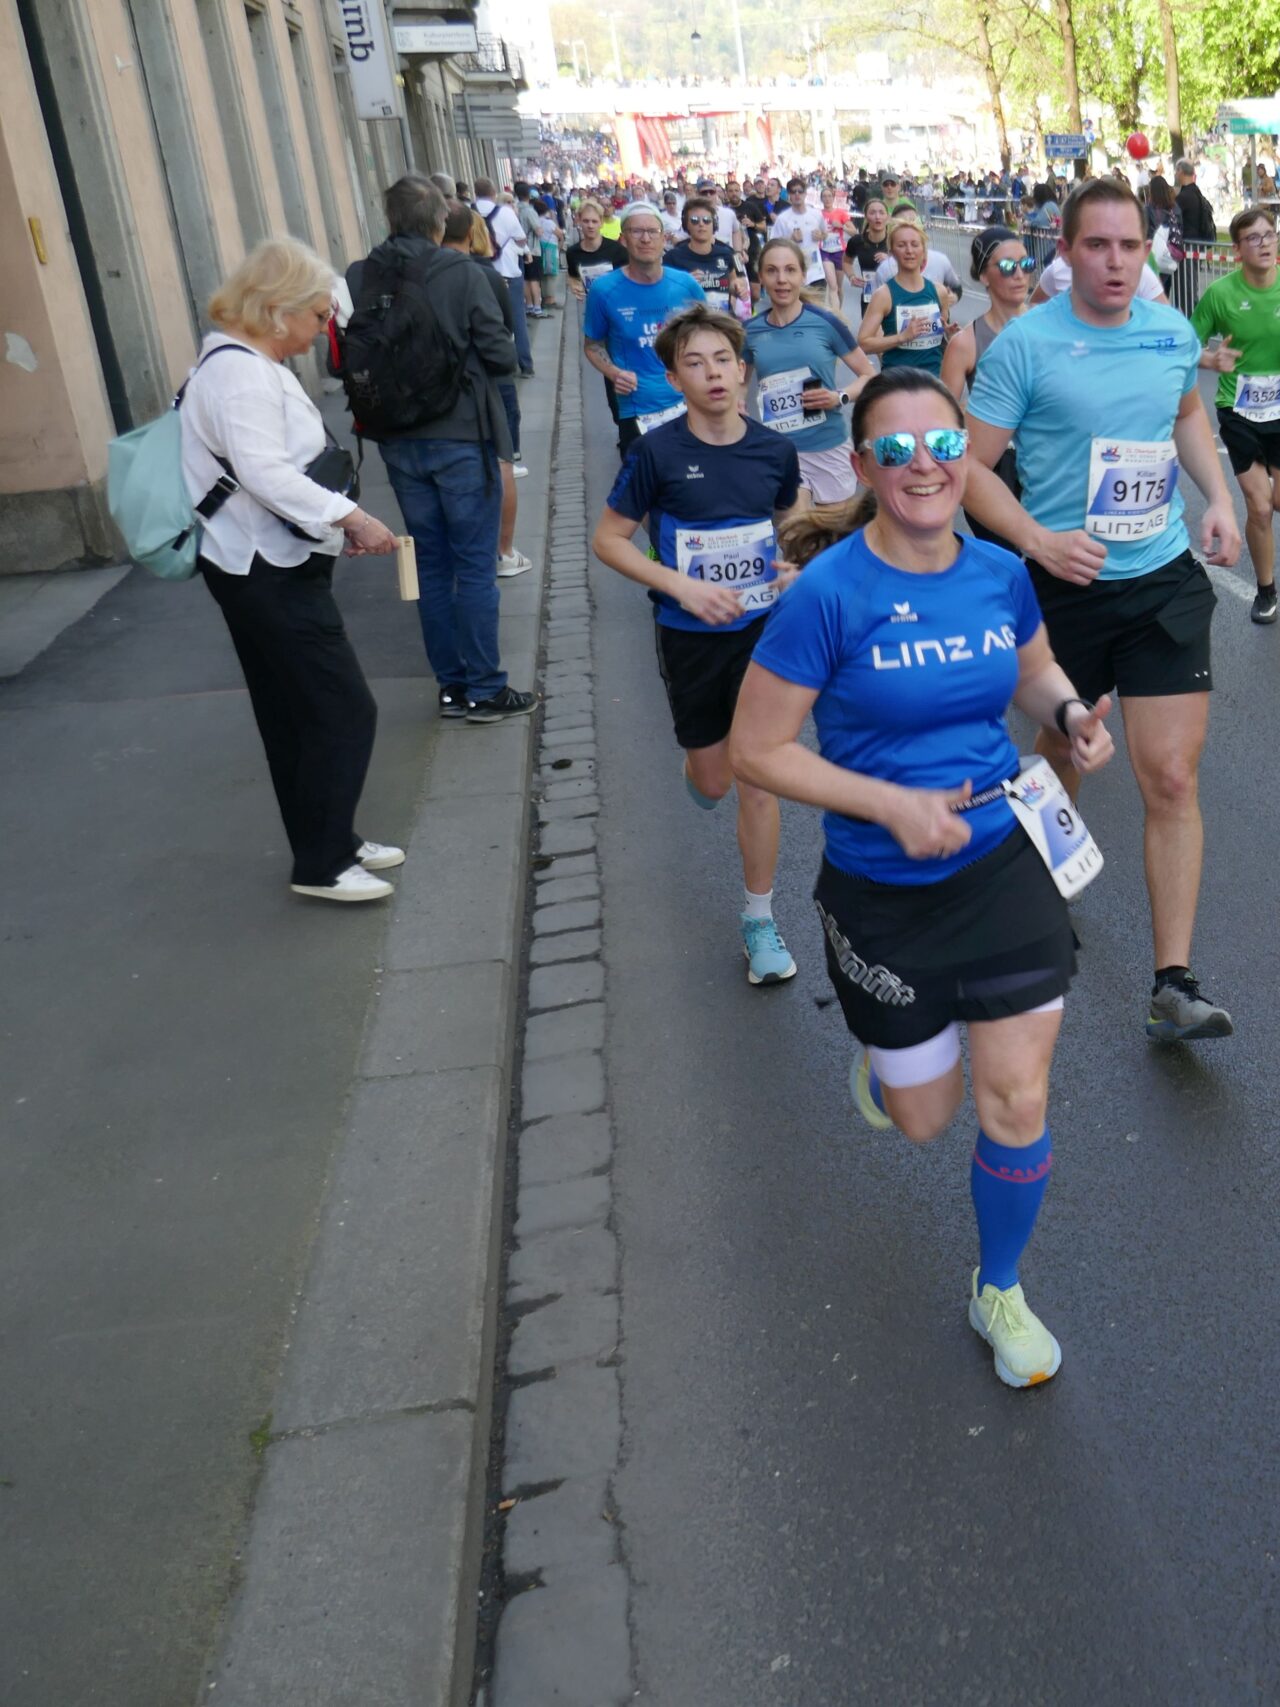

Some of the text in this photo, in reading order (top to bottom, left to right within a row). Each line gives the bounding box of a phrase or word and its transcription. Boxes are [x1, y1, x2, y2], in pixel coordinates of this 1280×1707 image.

[1113, 478, 1167, 503] 9175
[1093, 513, 1164, 535] LINZ AG
[695, 557, 765, 583] 13029
[745, 591, 774, 606] AG
[872, 635, 973, 671] LINZ
